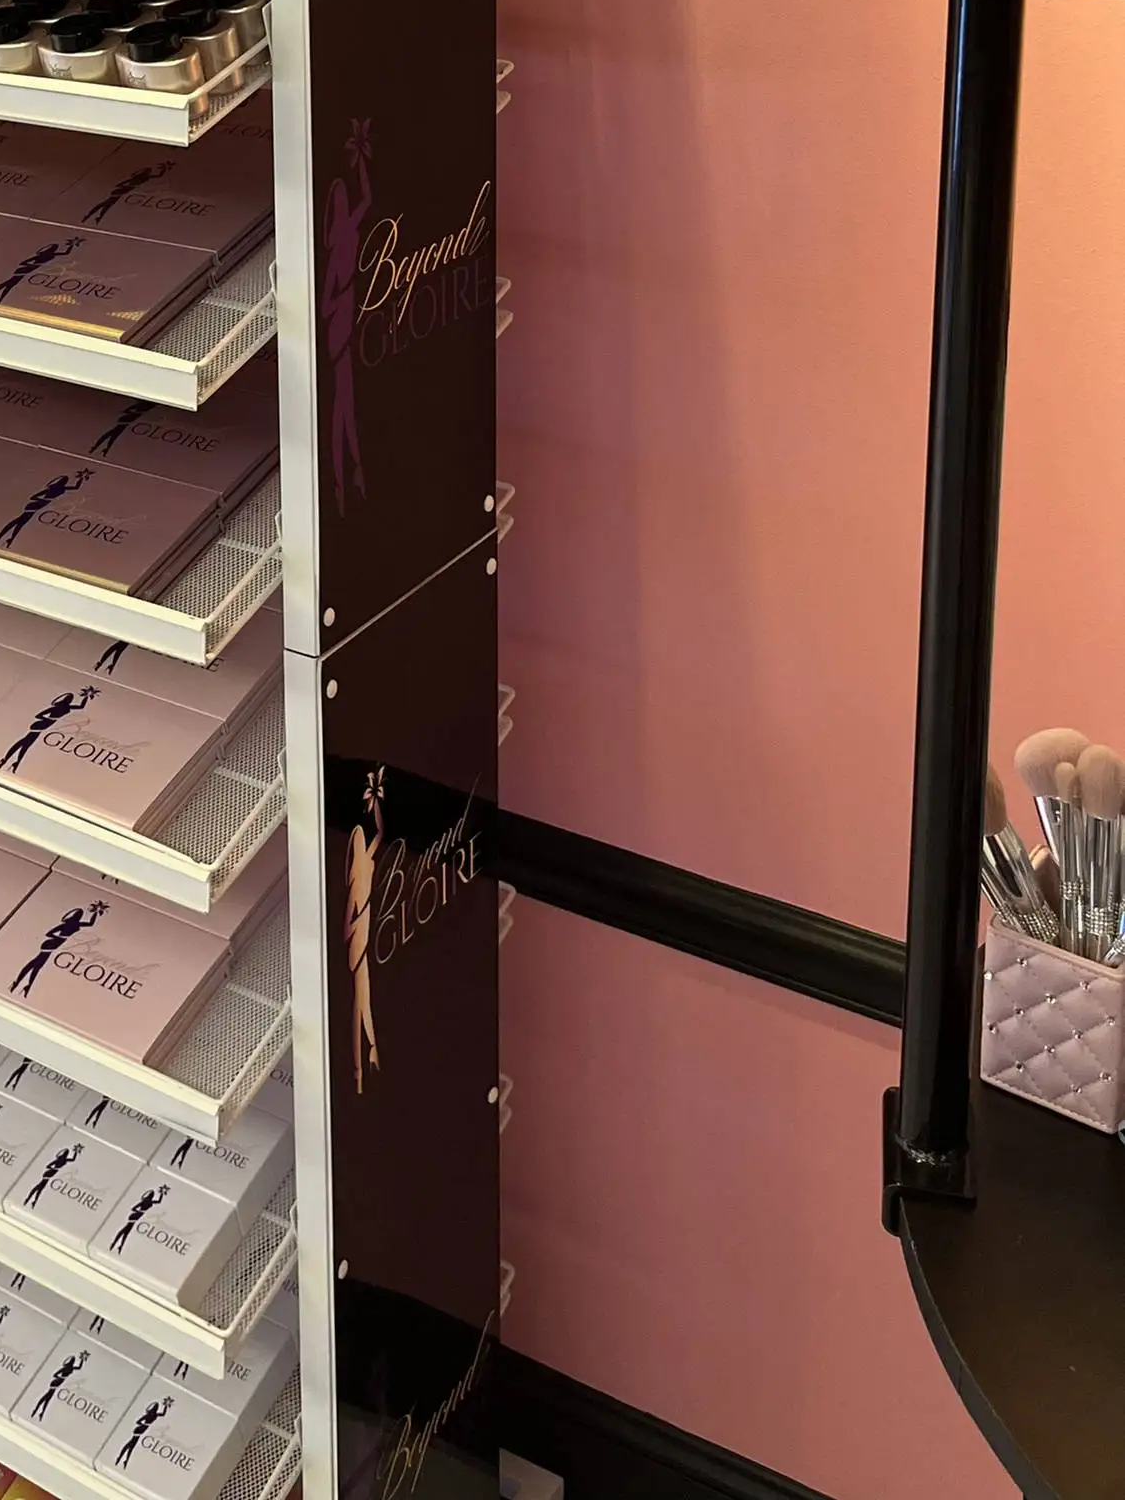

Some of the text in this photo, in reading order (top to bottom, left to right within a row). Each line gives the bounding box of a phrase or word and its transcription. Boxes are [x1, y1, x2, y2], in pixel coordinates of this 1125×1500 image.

[125, 193, 216, 217] GLOIRE
[357, 180, 490, 325] Beyond
[28, 272, 123, 301] GLOIRE
[130, 422, 220, 453] GLOIRE
[35, 509, 130, 545] GLOIRE
[42, 730, 135, 773] GLOIRE
[376, 831, 482, 964] GLOIRE
[53, 951, 143, 1000] GLOIRE
[30, 1062, 78, 1092] GLOIRE
[49, 1179, 103, 1211] GLOIRE
[135, 1220, 192, 1257] GLOIRE
[226, 1360, 252, 1381] IRE
[57, 1387, 109, 1424] GLOIRE
[141, 1435, 196, 1472] GLOIRE
